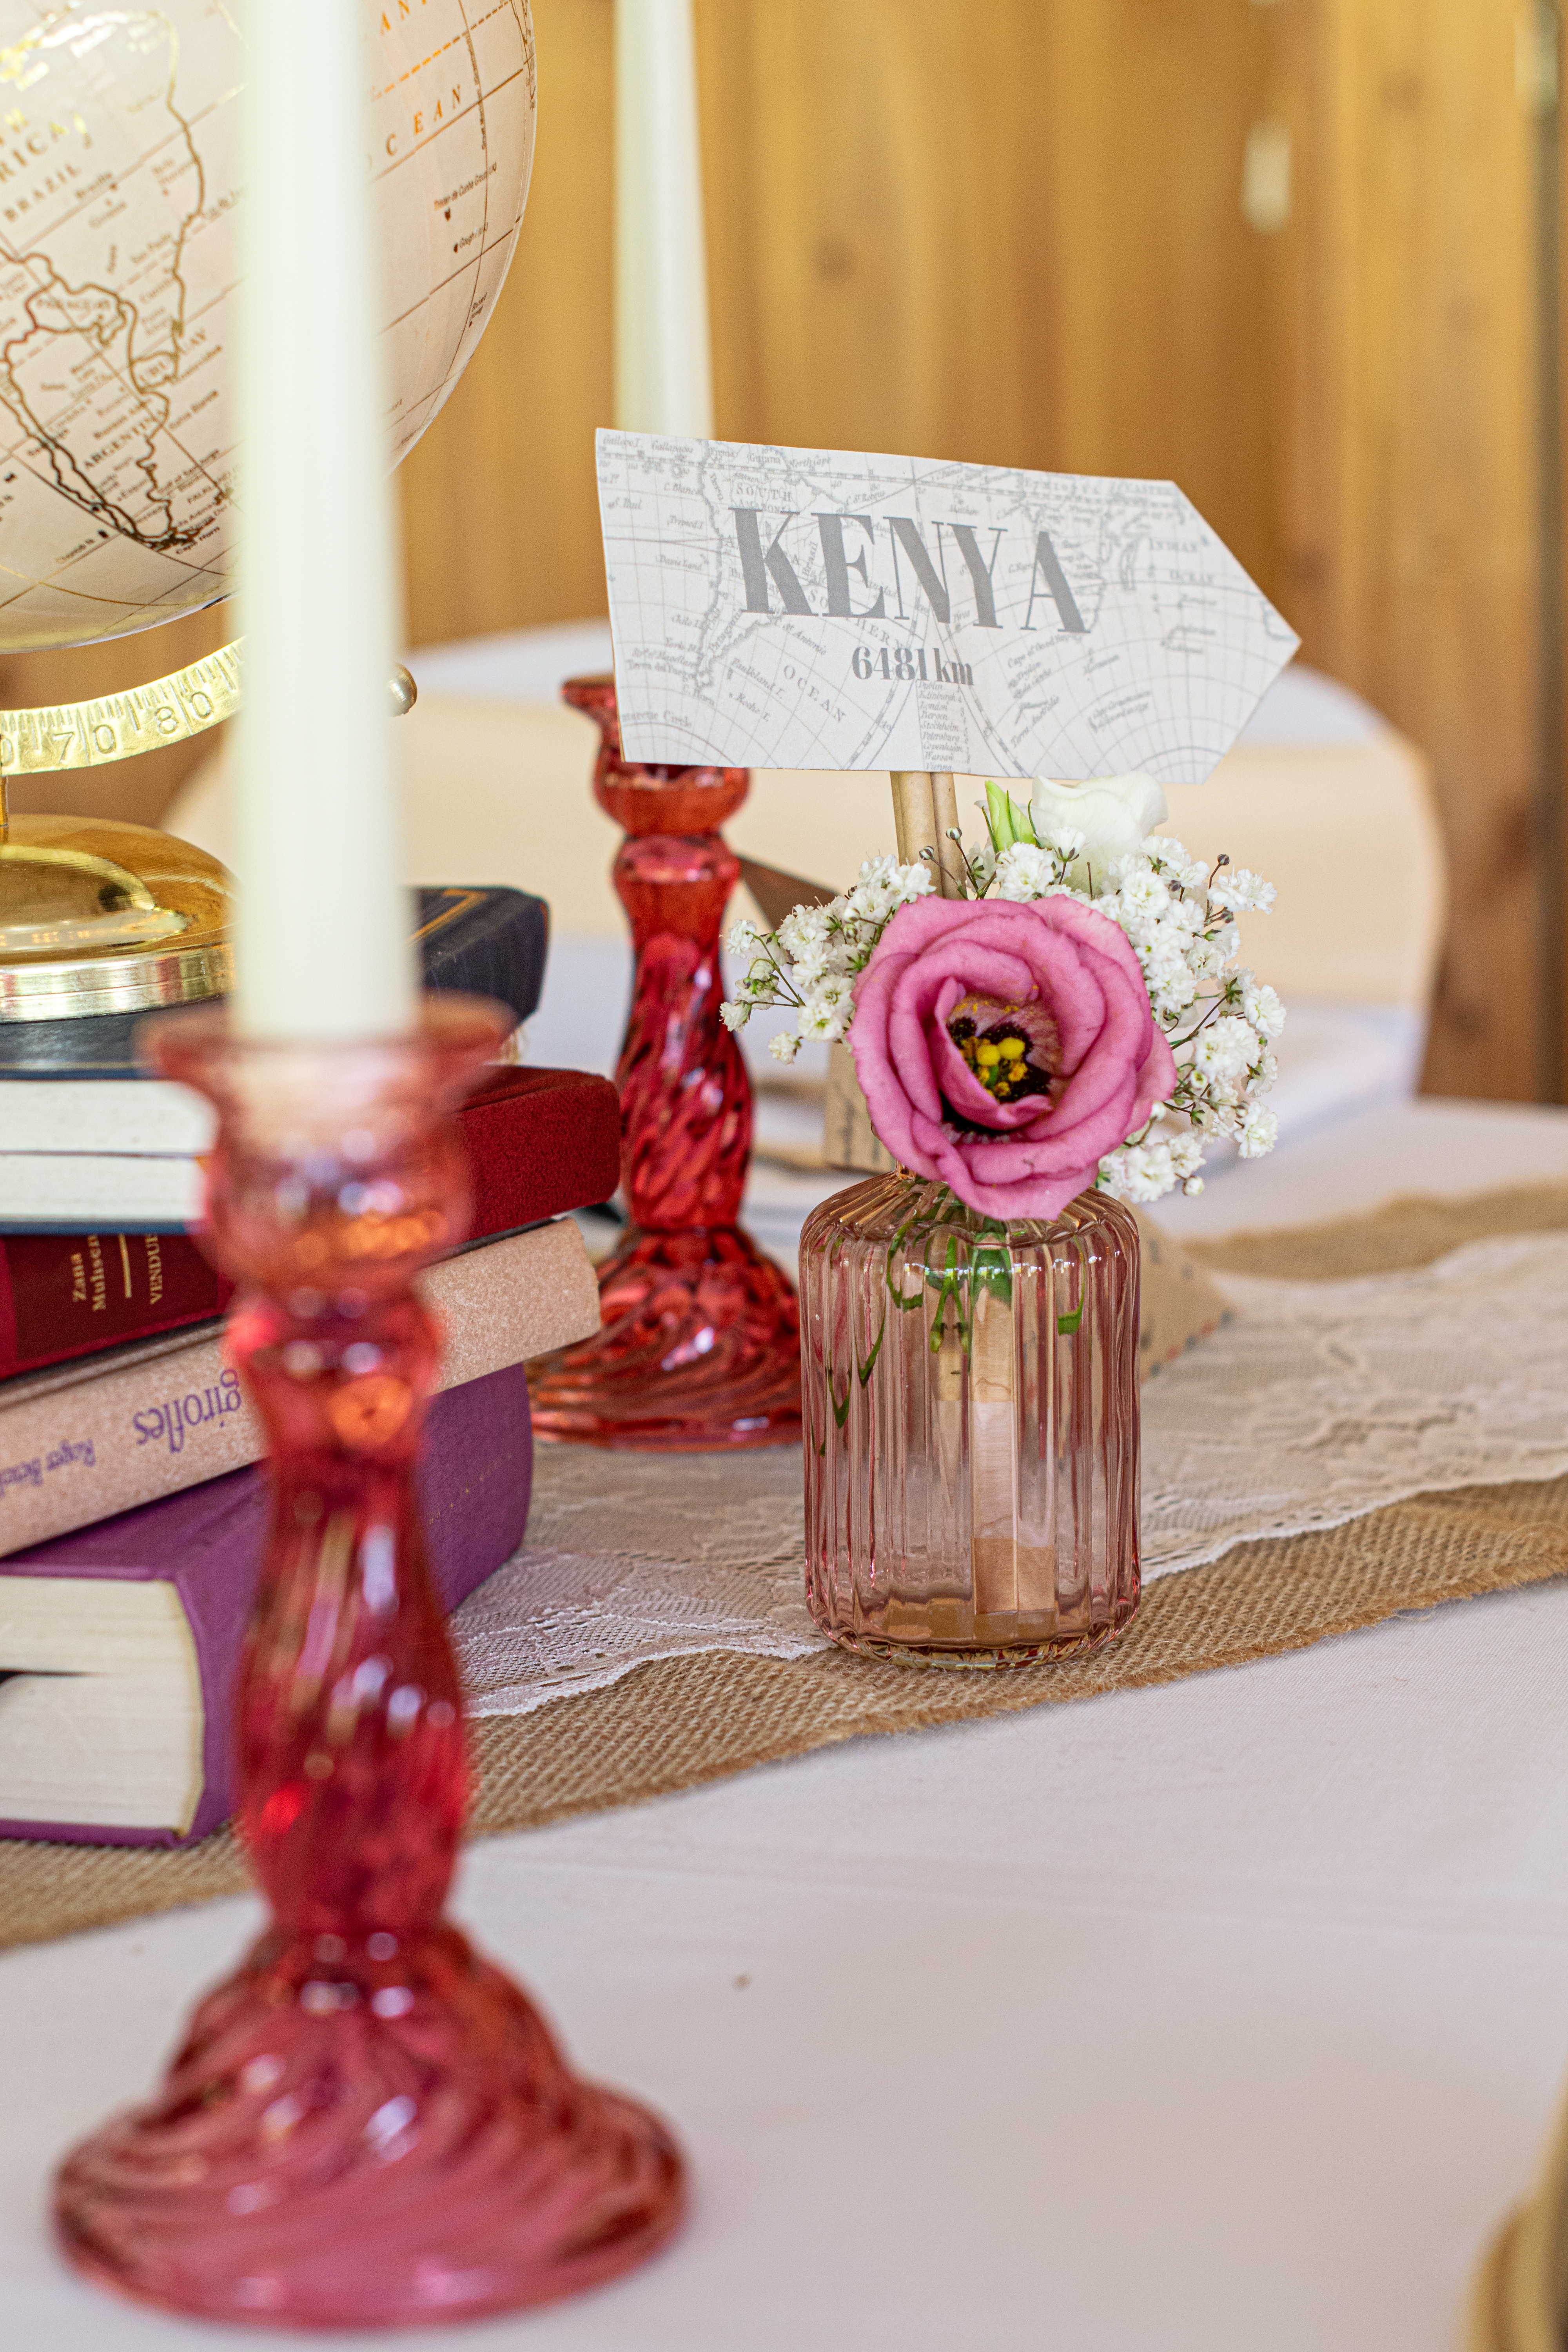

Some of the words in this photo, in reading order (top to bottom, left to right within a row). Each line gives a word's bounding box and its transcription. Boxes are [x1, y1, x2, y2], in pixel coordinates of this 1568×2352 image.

[736, 483, 792, 503] SOUTH
[728, 507, 1091, 633] KENYA
[851, 646, 929, 681] 6481
[933, 647, 975, 686] km
[53, 724, 116, 763] 70
[154, 690, 214, 735] 80
